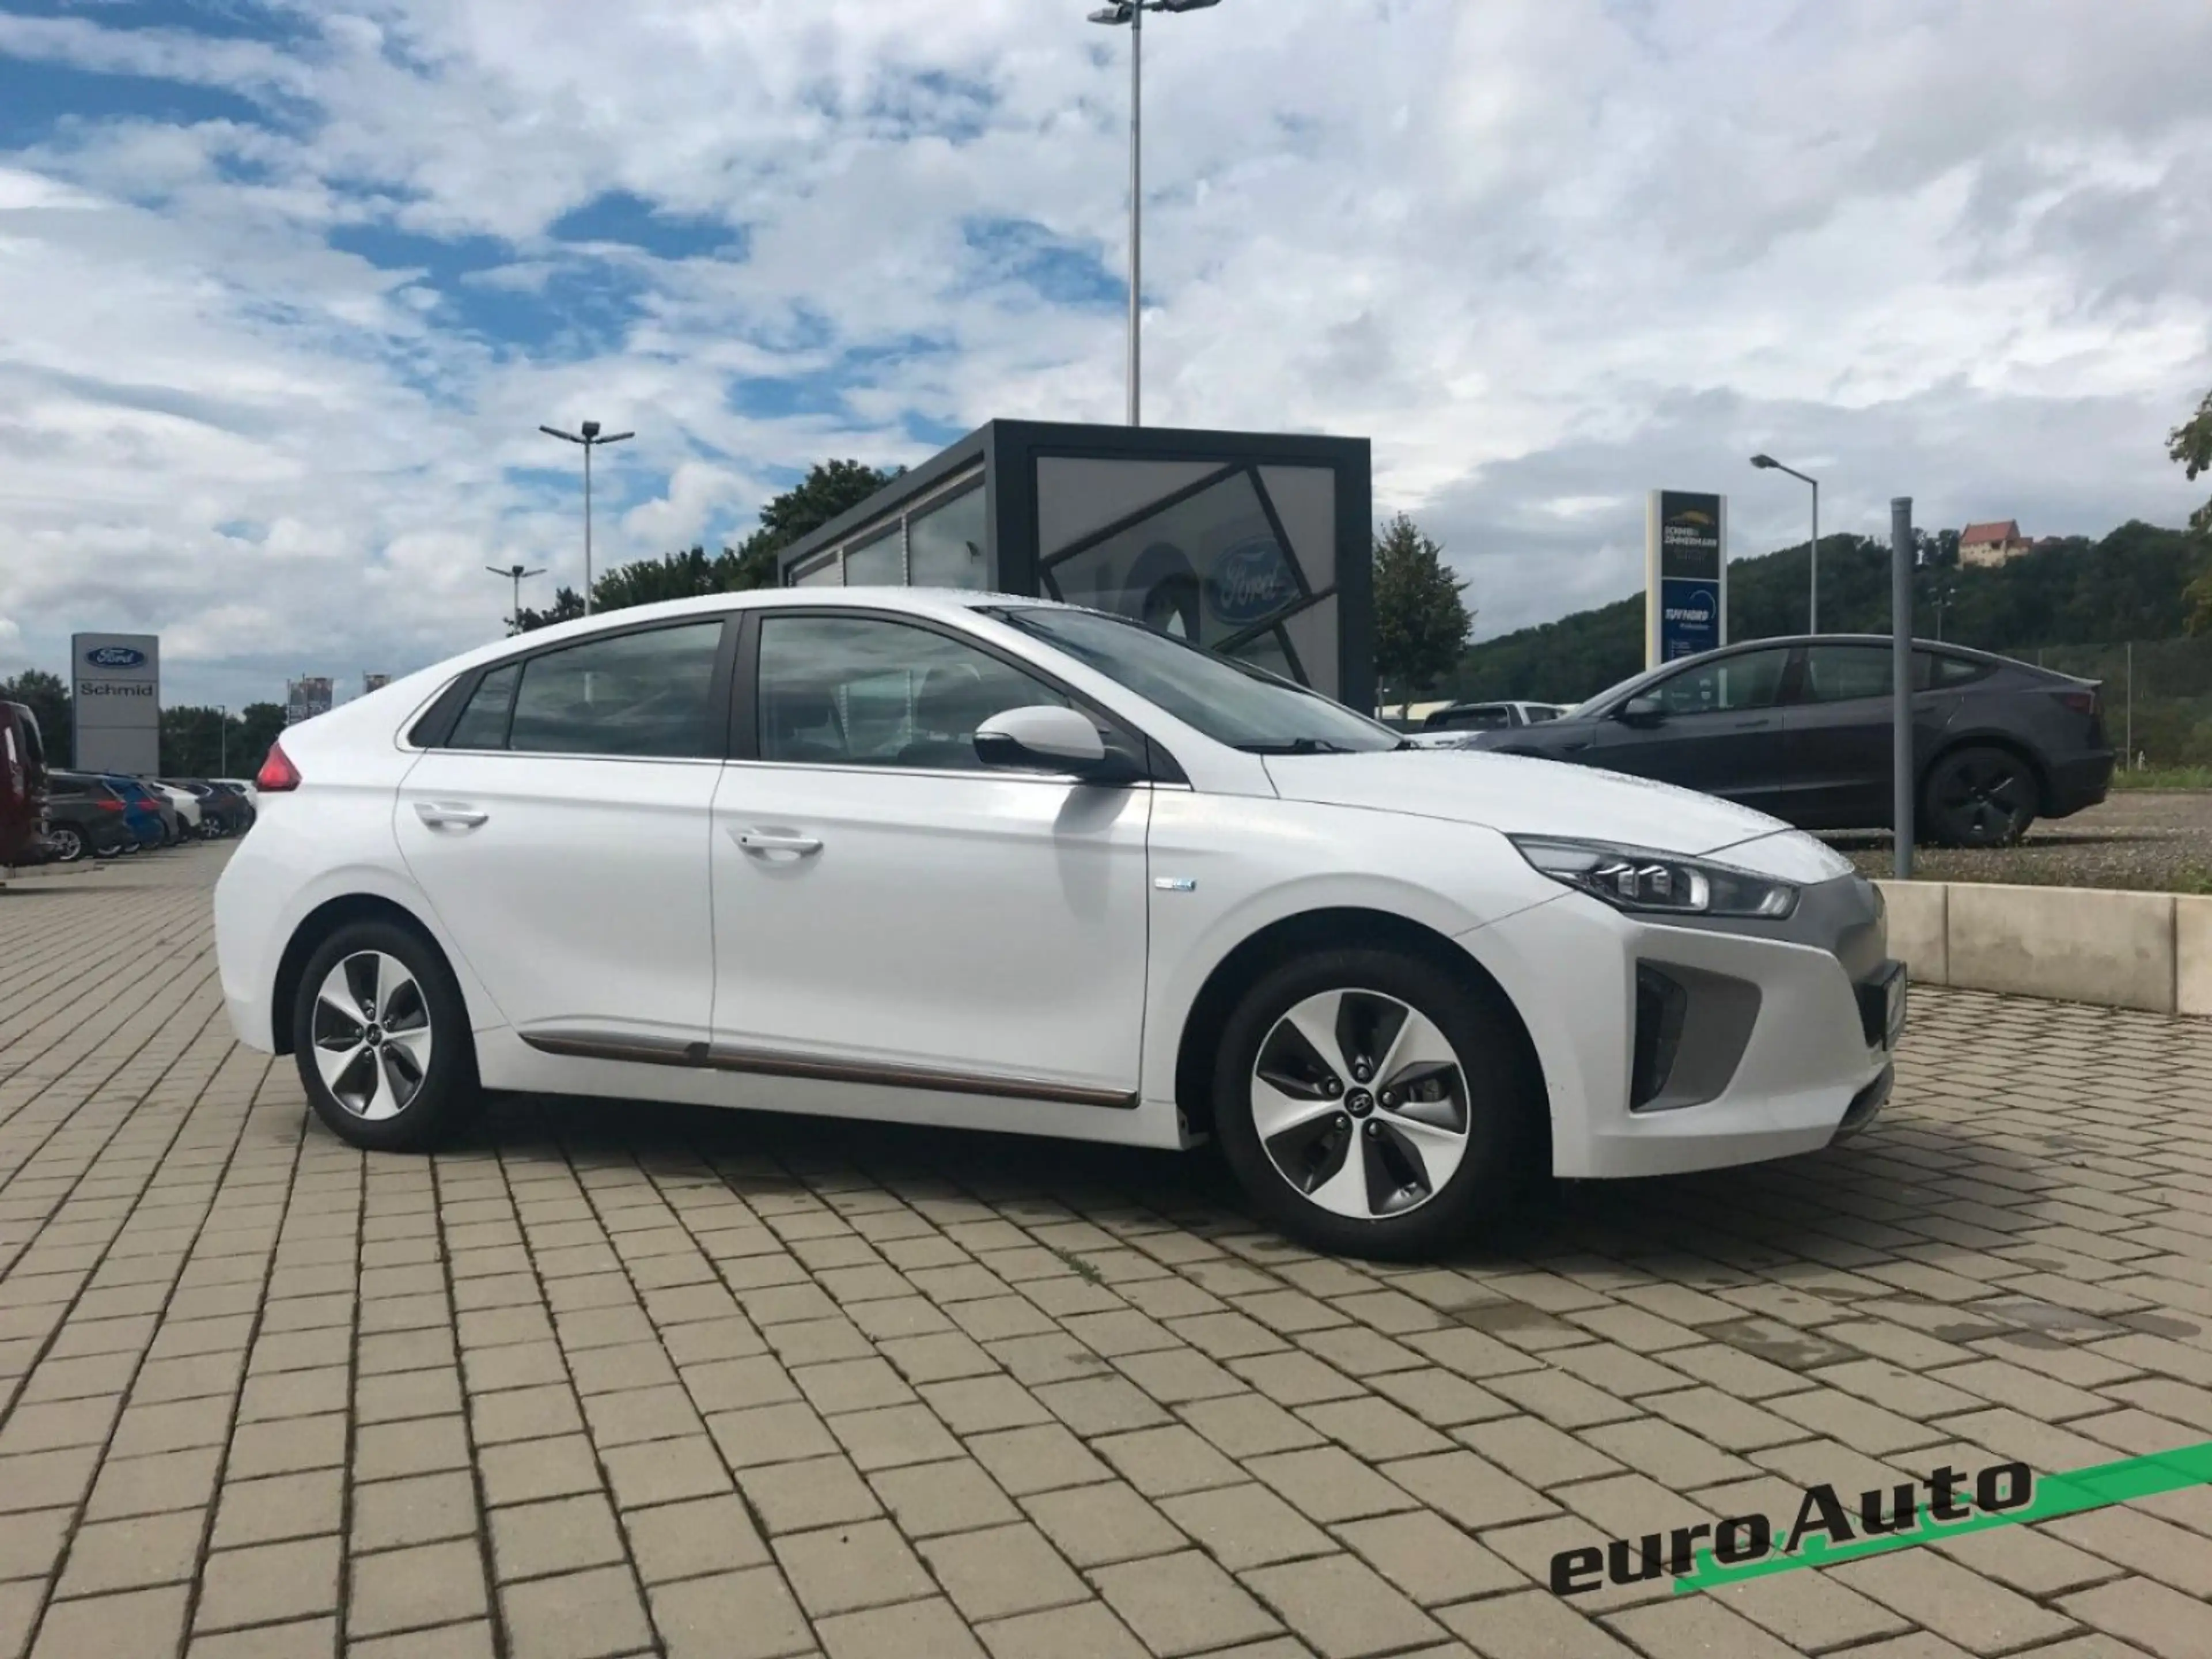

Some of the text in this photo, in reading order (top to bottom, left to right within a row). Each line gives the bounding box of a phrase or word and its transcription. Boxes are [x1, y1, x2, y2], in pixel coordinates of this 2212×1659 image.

[1219, 551, 1283, 610] Ford
[96, 649, 136, 664] Ford
[81, 683, 153, 698] Schmid
